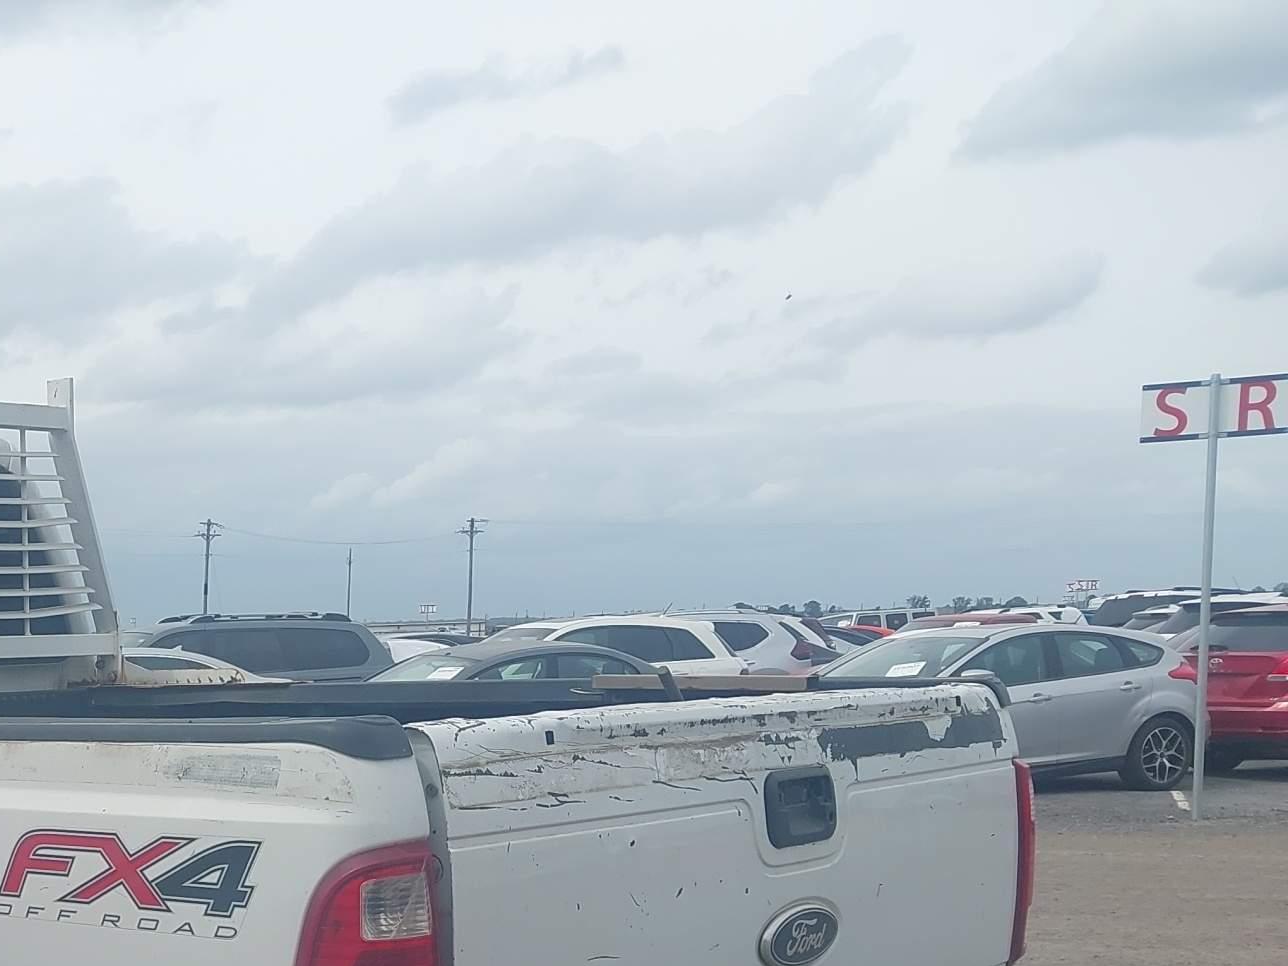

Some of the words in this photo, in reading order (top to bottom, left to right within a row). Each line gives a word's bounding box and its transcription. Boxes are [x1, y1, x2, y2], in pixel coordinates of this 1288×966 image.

[1153, 388, 1188, 437] S
[1238, 381, 1277, 432] R
[786, 919, 826, 956] Ford
